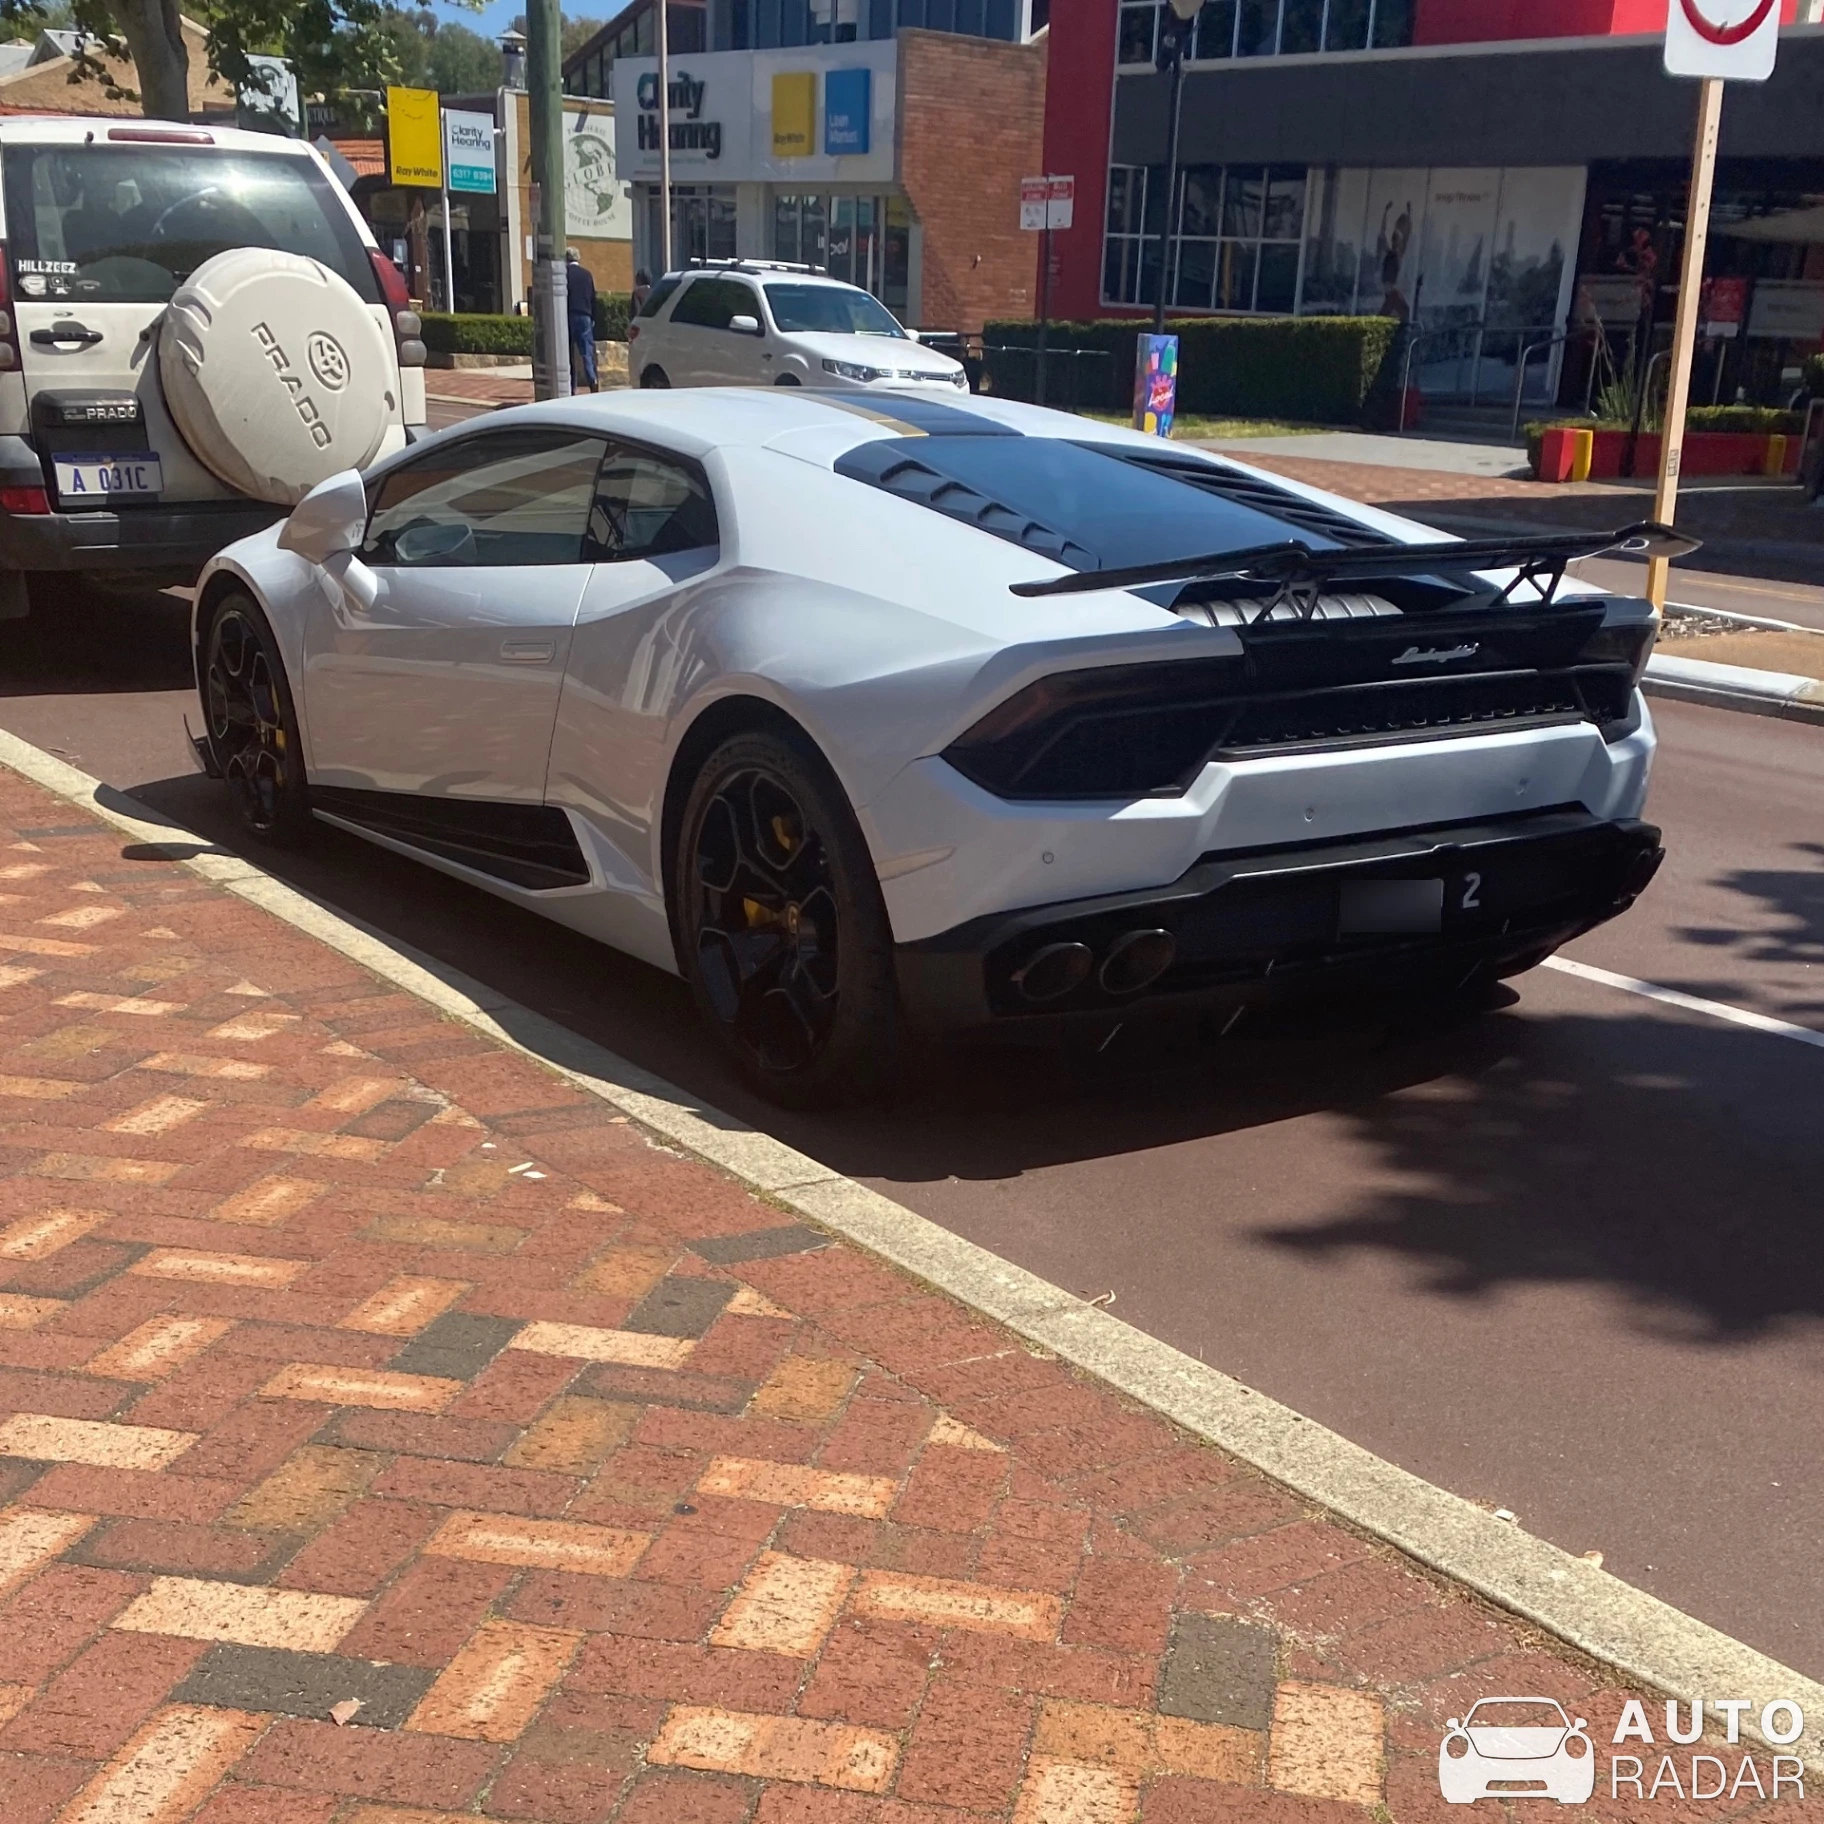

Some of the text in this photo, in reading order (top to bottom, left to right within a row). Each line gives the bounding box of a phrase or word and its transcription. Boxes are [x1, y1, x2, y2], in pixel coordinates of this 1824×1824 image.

[451, 124, 484, 138] Clarity
[451, 135, 491, 151] Hearing
[396, 165, 438, 178] Ray White
[250, 321, 332, 450] PRADO
[1148, 384, 1174, 408] Local
[86, 406, 137, 420] PRADO
[73, 466, 148, 493] A 031C
[1462, 872, 1481, 909] 2
